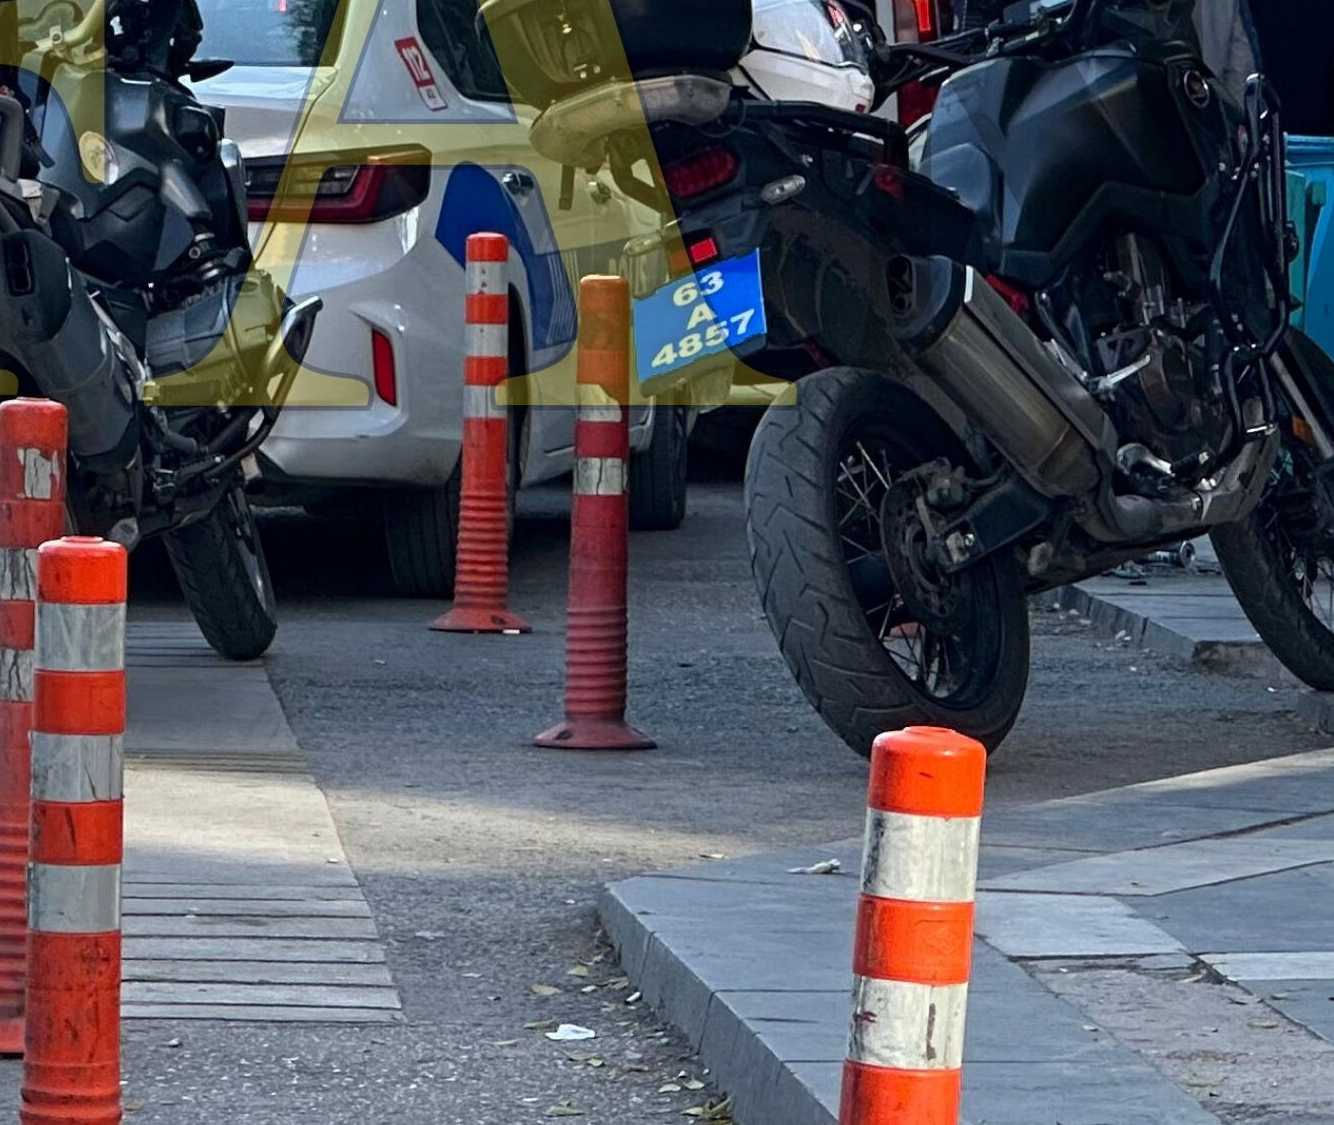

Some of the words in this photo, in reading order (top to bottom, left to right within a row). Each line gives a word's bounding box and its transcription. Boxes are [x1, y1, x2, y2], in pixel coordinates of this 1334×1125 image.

[673, 271, 725, 307] 63
[686, 302, 717, 330] A
[651, 308, 755, 368] 4857
